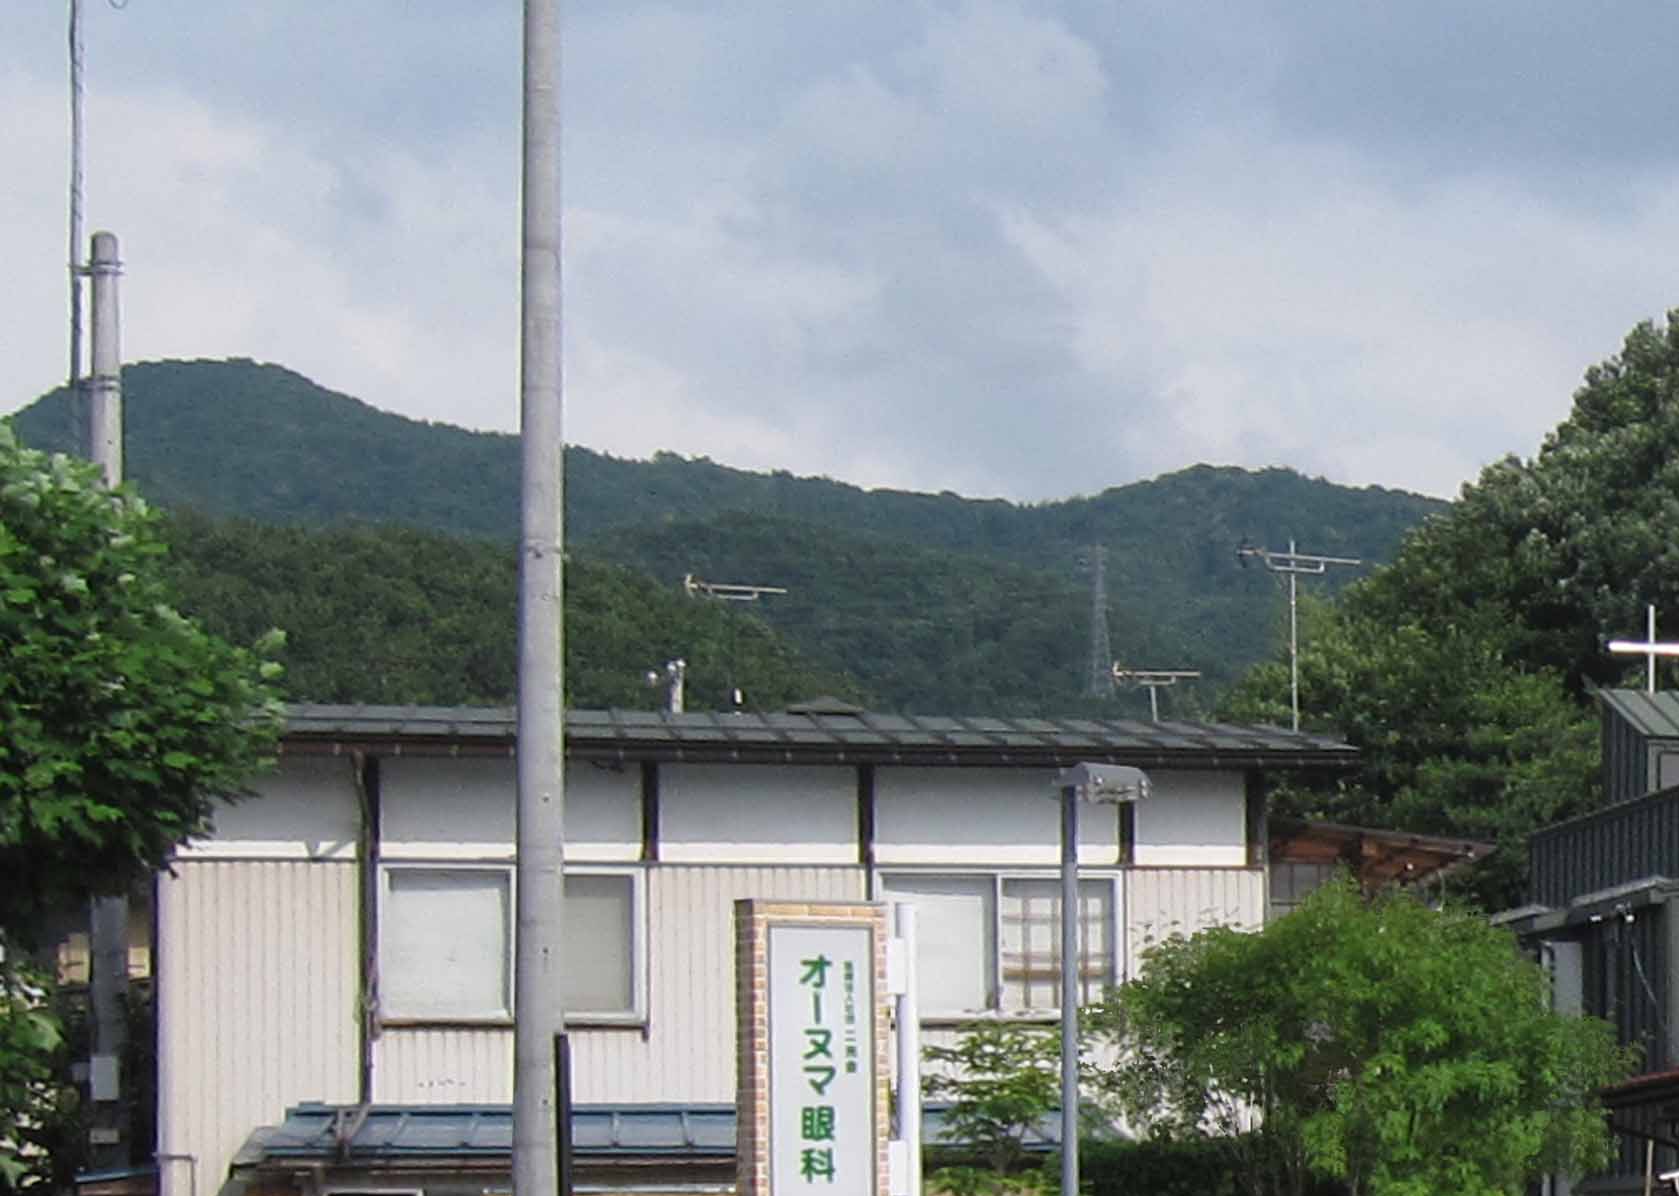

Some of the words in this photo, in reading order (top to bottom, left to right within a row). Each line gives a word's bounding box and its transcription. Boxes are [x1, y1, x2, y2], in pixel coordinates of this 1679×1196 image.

[799, 954, 836, 1185] オーヌマ眼科
